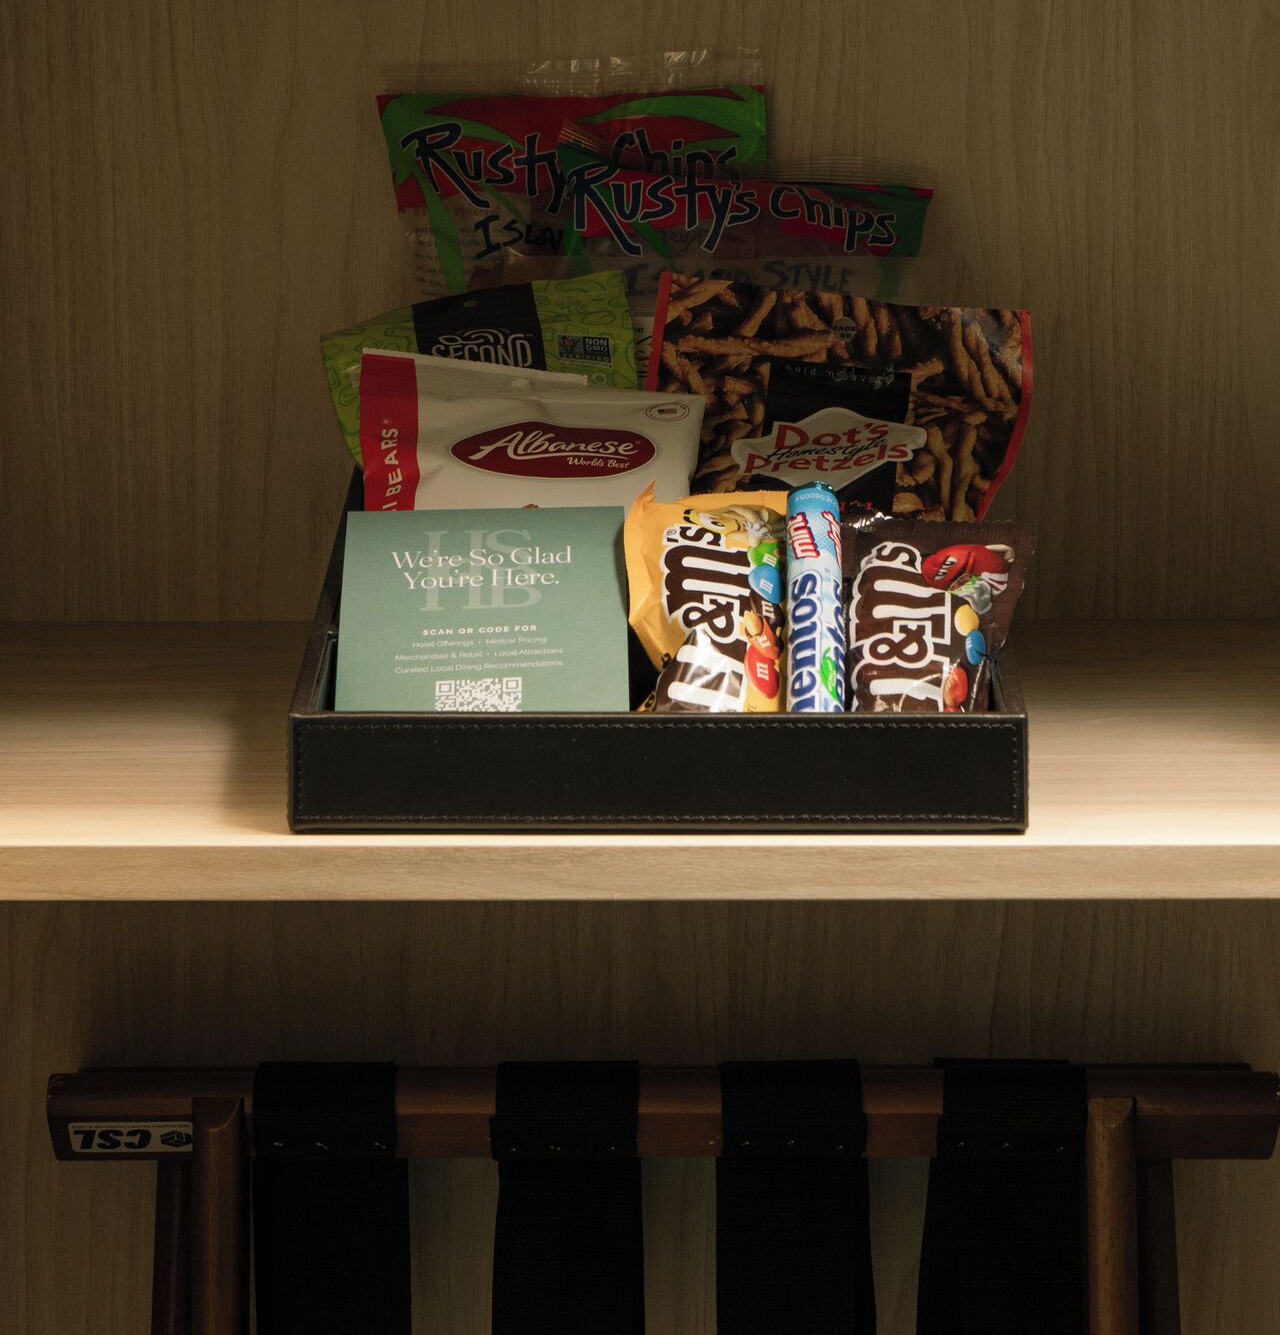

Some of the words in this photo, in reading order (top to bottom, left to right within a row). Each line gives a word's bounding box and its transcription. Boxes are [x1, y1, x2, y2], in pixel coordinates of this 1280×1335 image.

[401, 122, 568, 215] Rusty
[566, 161, 761, 258] Rusty's
[769, 184, 897, 253] Chips
[474, 214, 564, 259] ISLA
[585, 338, 607, 346] NON
[585, 344, 608, 352] GMO
[469, 430, 640, 460] Albanese
[774, 422, 889, 450] Dot's
[383, 427, 401, 496] BEARS
[607, 459, 630, 469] Best
[744, 443, 908, 474] Pretzels
[788, 513, 818, 558] mint
[392, 549, 463, 569] We're
[470, 548, 504, 567] So
[510, 546, 572, 565] Glad
[403, 570, 484, 590] You're
[490, 569, 560, 587] Here.
[422, 628, 453, 636] SCAN
[478, 626, 510, 634] CODE
[412, 641, 435, 649] Hotel
[436, 640, 474, 648] Offerings
[486, 637, 516, 645] Minibar
[518, 636, 547, 644] Pricing
[395, 652, 449, 662] Merchandise
[494, 649, 517, 657] Local
[518, 648, 564, 656] Attractions
[394, 666, 429, 674] Curated
[430, 665, 454, 673] Local
[455, 664, 482, 672] Dining
[483, 660, 564, 670] Recommendations
[73, 1129, 152, 1150] CSL
